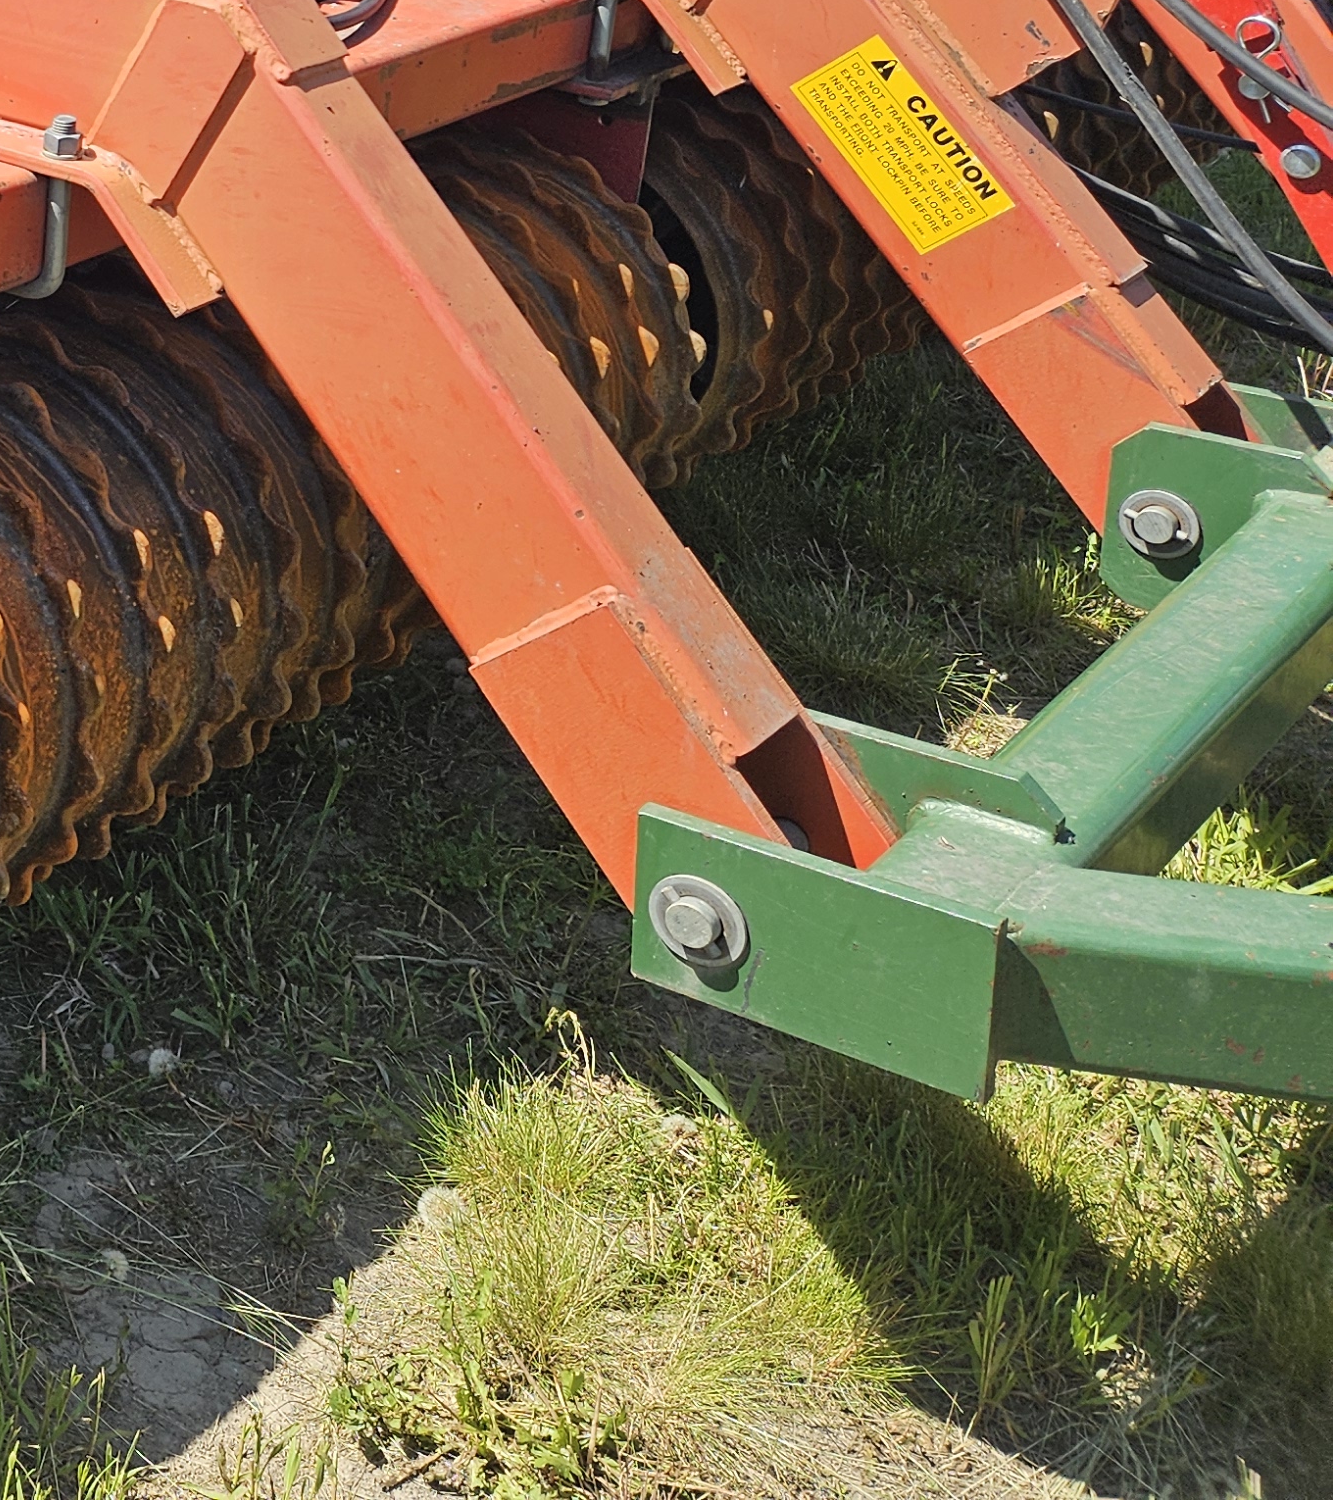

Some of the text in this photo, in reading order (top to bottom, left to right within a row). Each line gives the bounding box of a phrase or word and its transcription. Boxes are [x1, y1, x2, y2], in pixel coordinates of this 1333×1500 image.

[806, 87, 867, 159] TRANSPORTING.
[817, 80, 837, 102] AND
[834, 102, 854, 123] THE
[849, 122, 879, 154] FRONT
[875, 154, 912, 196] LOCKPIN
[907, 195, 942, 234] BEFORE
[828, 74, 862, 112] INSTALL
[857, 112, 883, 140] BOTH
[880, 140, 928, 195] TRANSPORT
[923, 194, 953, 228] LOCKS
[839, 67, 884, 120] EXCEEDING
[881, 121, 896, 134] 20
[913, 161, 929, 176] BE
[926, 177, 951, 204] SURE
[949, 206, 965, 221] TO
[850, 60, 977, 215] DO NOT TRANSPORT AT SPEEDS
[903, 92, 998, 201] CAUTION
